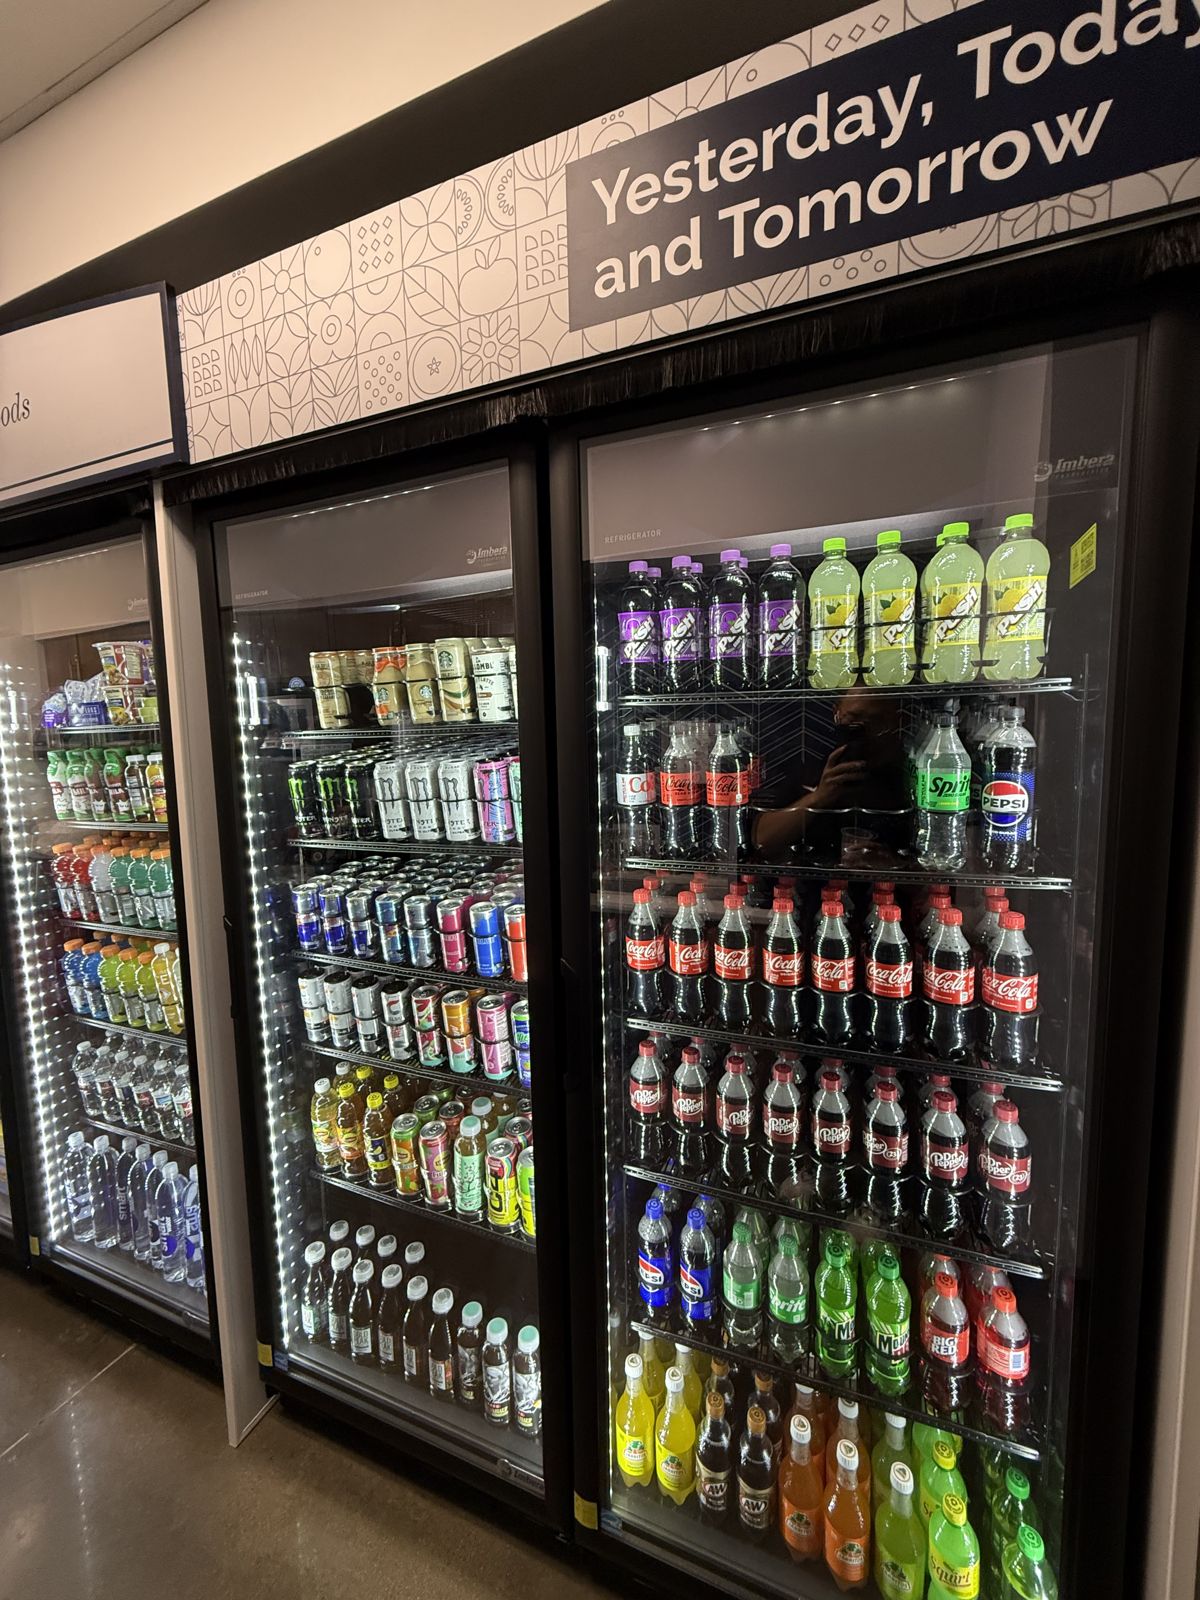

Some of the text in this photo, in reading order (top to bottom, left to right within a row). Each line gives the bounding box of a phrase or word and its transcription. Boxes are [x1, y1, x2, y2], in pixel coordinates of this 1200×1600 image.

[591, 73, 934, 226] Yesterday,
[593, 99, 1114, 300] and Tomorrow
[1054, 454, 1116, 474] Imbera
[604, 529, 662, 544] REFRIGERATOR
[476, 546, 508, 559] Imbera
[983, 796, 1026, 809] PEPSI
[930, 1152, 964, 1169] Pepper
[933, 1335, 956, 1347] BIG
[931, 1345, 957, 1355] RED
[931, 1555, 970, 1585] Squirt
